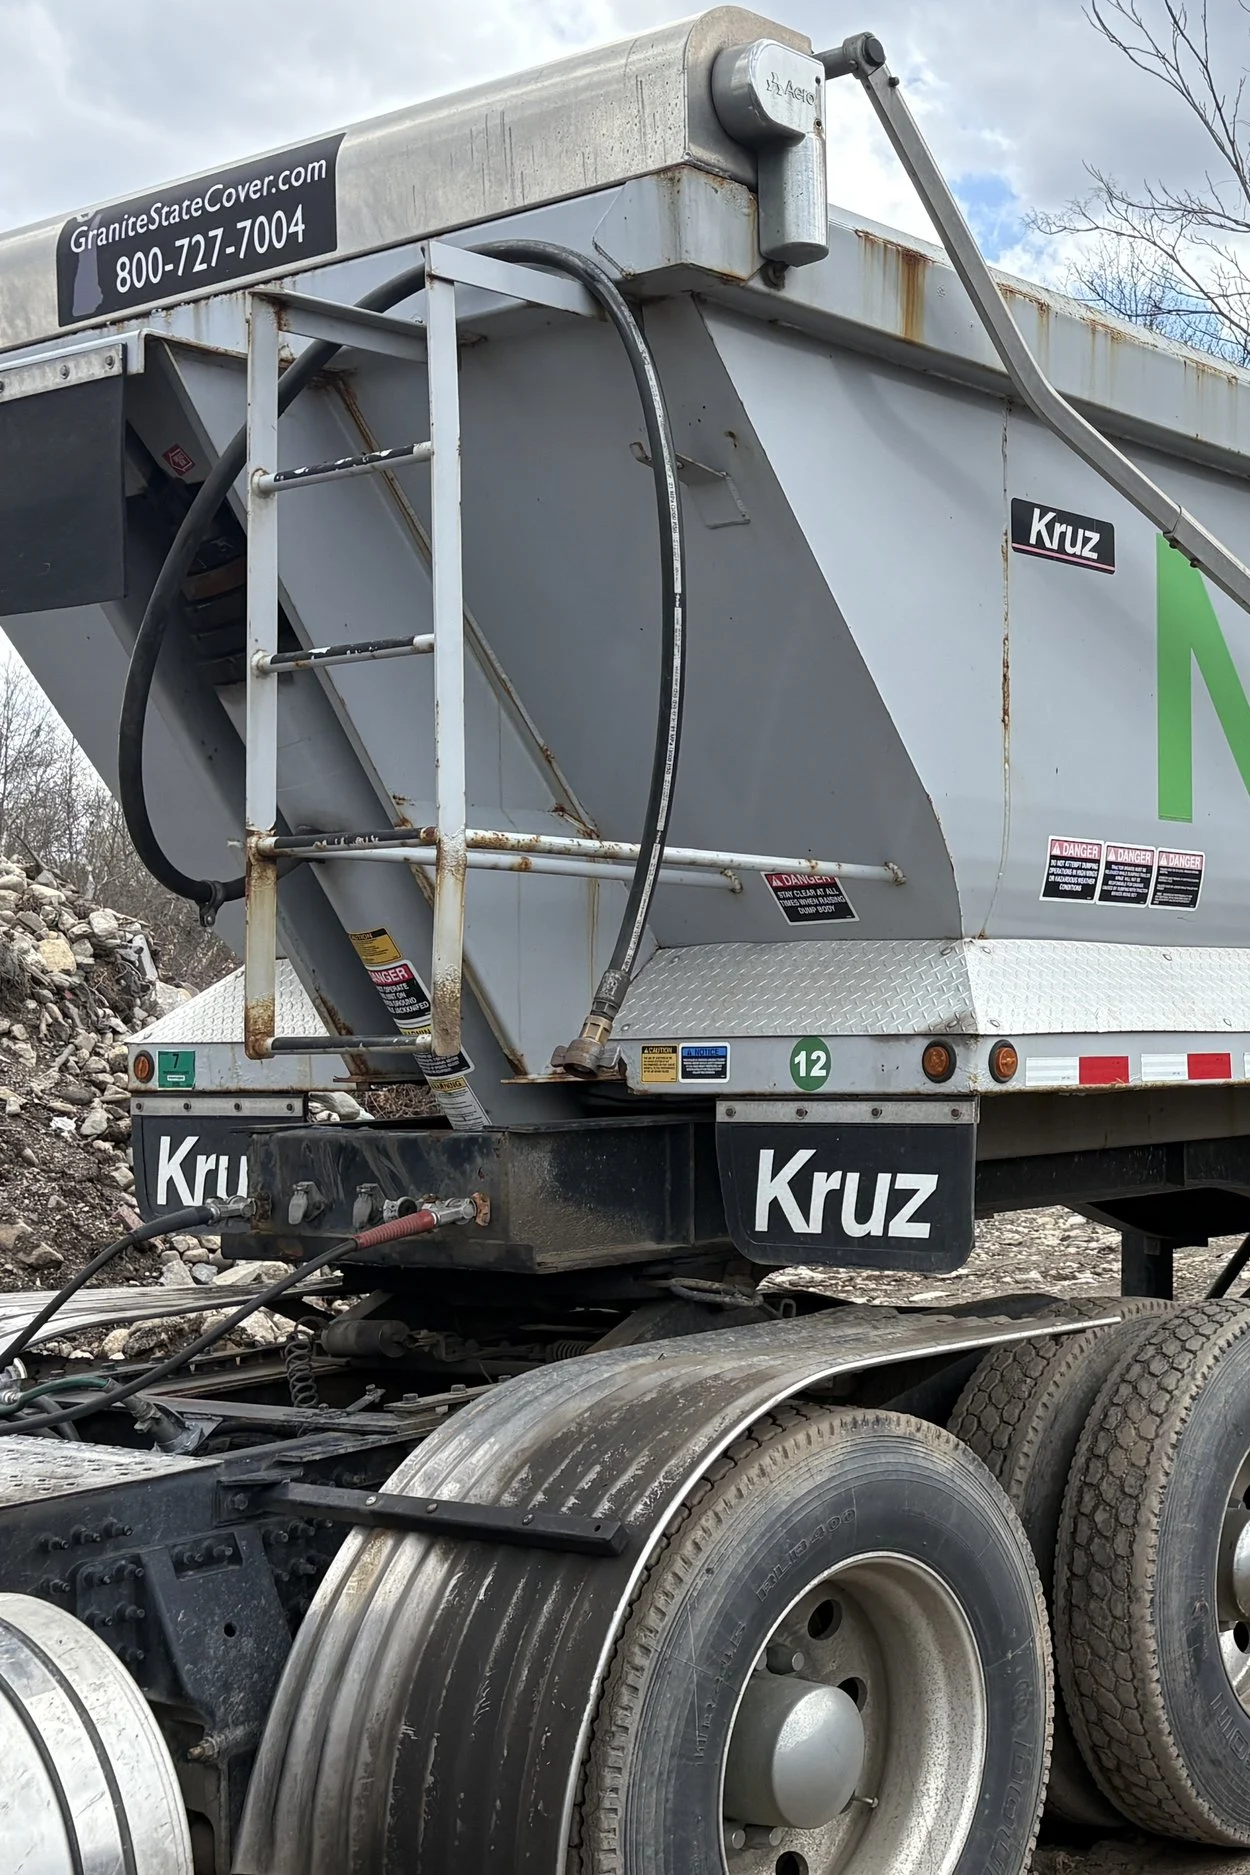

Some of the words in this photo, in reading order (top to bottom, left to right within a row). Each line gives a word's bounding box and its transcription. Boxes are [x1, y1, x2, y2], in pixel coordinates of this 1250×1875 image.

[784, 80, 815, 105] Aero
[70, 158, 327, 254] GraniteStateCover.com
[115, 204, 305, 294] 800-727-7004
[1029, 508, 1101, 560] Kruz
[1062, 843, 1099, 860] DANGER
[1118, 849, 1152, 864] DANGER
[1169, 854, 1201, 869] DANGER
[777, 891, 793, 899] STAY
[793, 889, 816, 898] CLEAR
[816, 888, 825, 897] AT
[826, 887, 839, 895] ALL
[779, 899, 800, 907] TIMES
[799, 897, 818, 905] WHEN
[819, 895, 846, 904] RAISING
[798, 906, 817, 914] DUMP
[817, 905, 836, 913] BODY
[695, 1048, 720, 1056] NOTICE
[172, 1053, 180, 1069] 7
[794, 1051, 827, 1078] 12
[157, 1135, 249, 1207] Kru
[754, 1148, 939, 1239] Kruz
